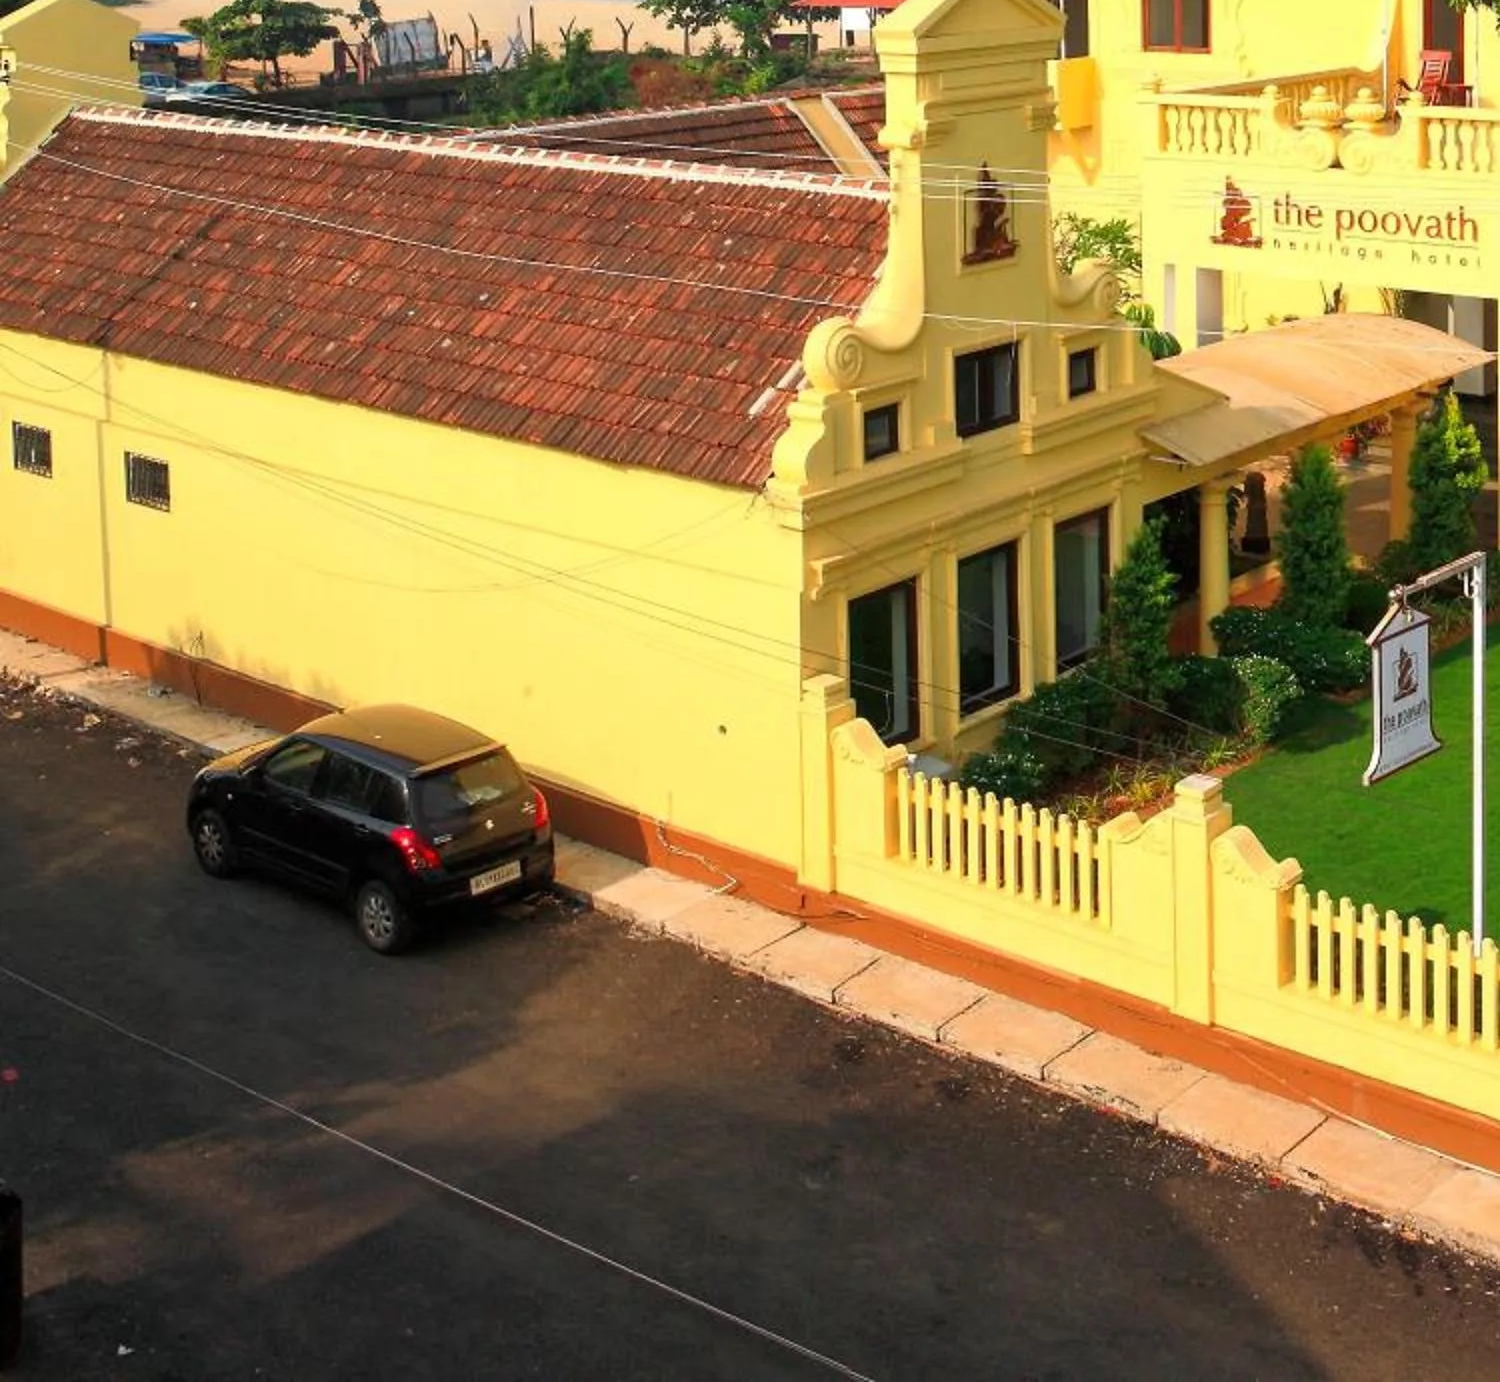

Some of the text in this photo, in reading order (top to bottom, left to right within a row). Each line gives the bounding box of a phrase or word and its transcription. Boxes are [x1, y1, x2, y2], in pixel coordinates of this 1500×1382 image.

[1273, 192, 1479, 242] the poovath
[1411, 249, 1481, 267] hotel
